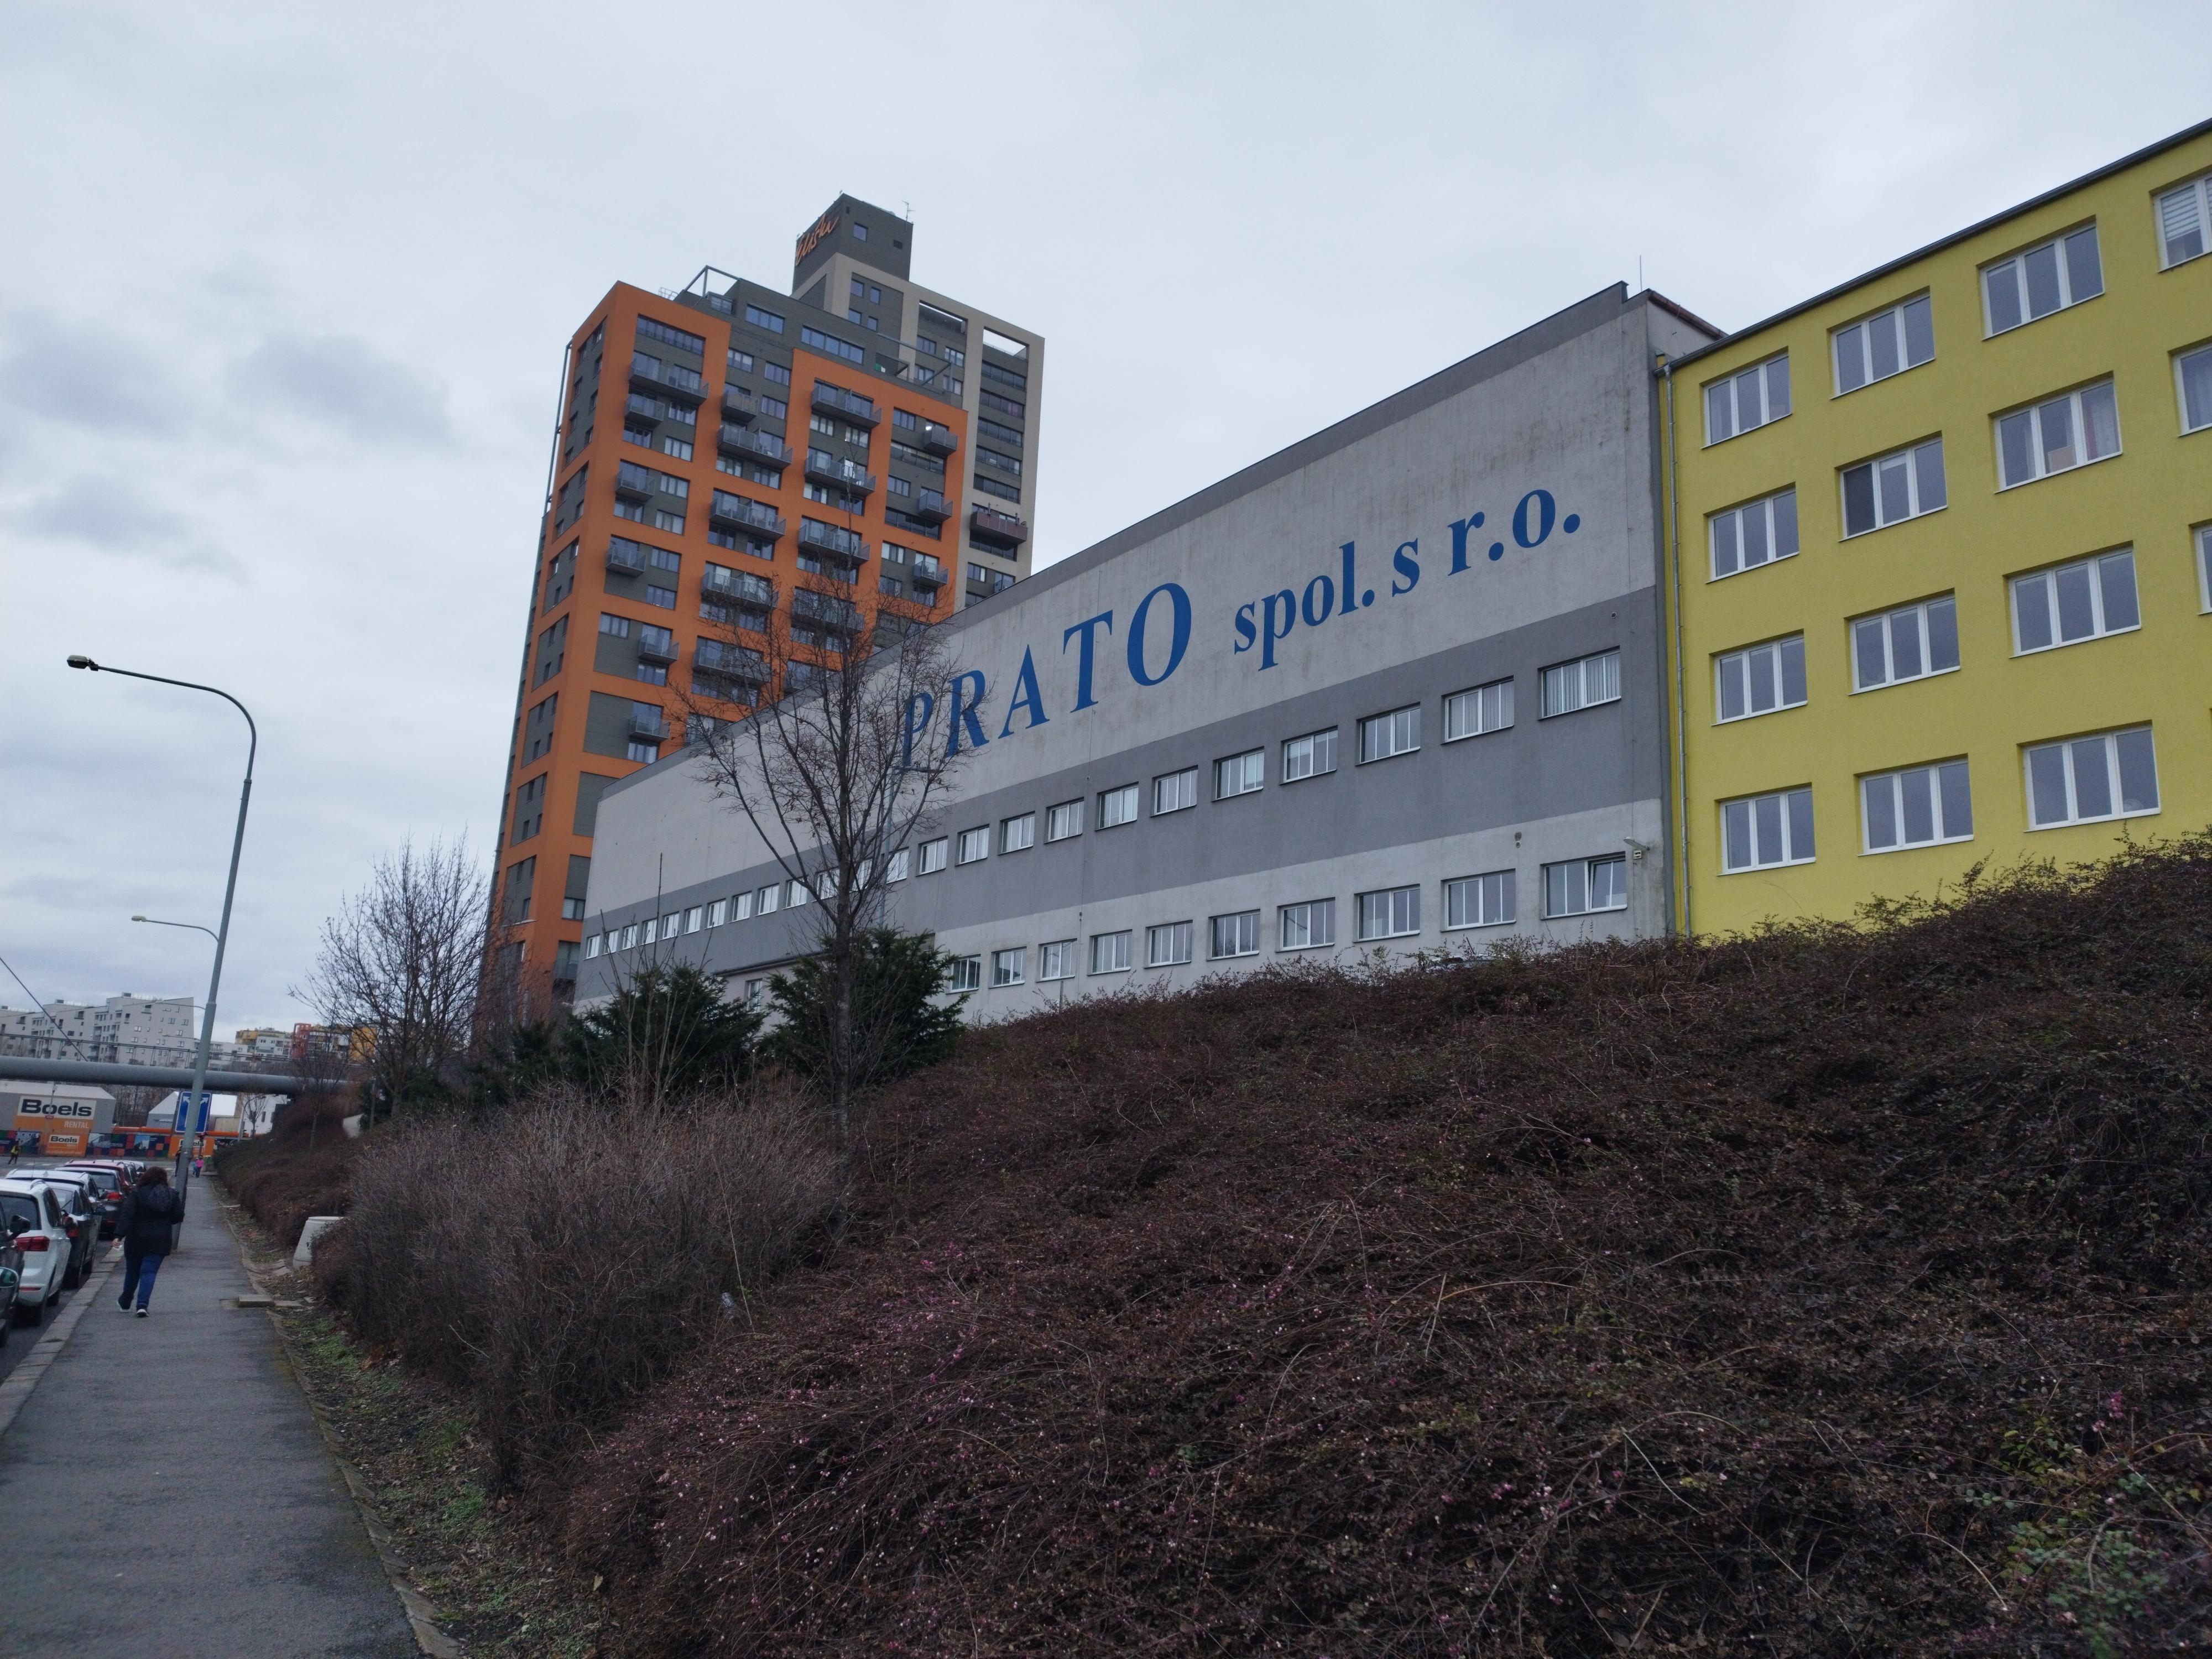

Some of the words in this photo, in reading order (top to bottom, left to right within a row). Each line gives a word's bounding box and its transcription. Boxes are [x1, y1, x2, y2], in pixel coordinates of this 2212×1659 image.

[901, 582, 1192, 767] PRATO
[1234, 540, 1375, 671] spol.
[1392, 538, 1420, 597] s
[1447, 489, 1580, 576] r.o.
[20, 1099, 92, 1117] Boels
[64, 1120, 89, 1129] RENTAL
